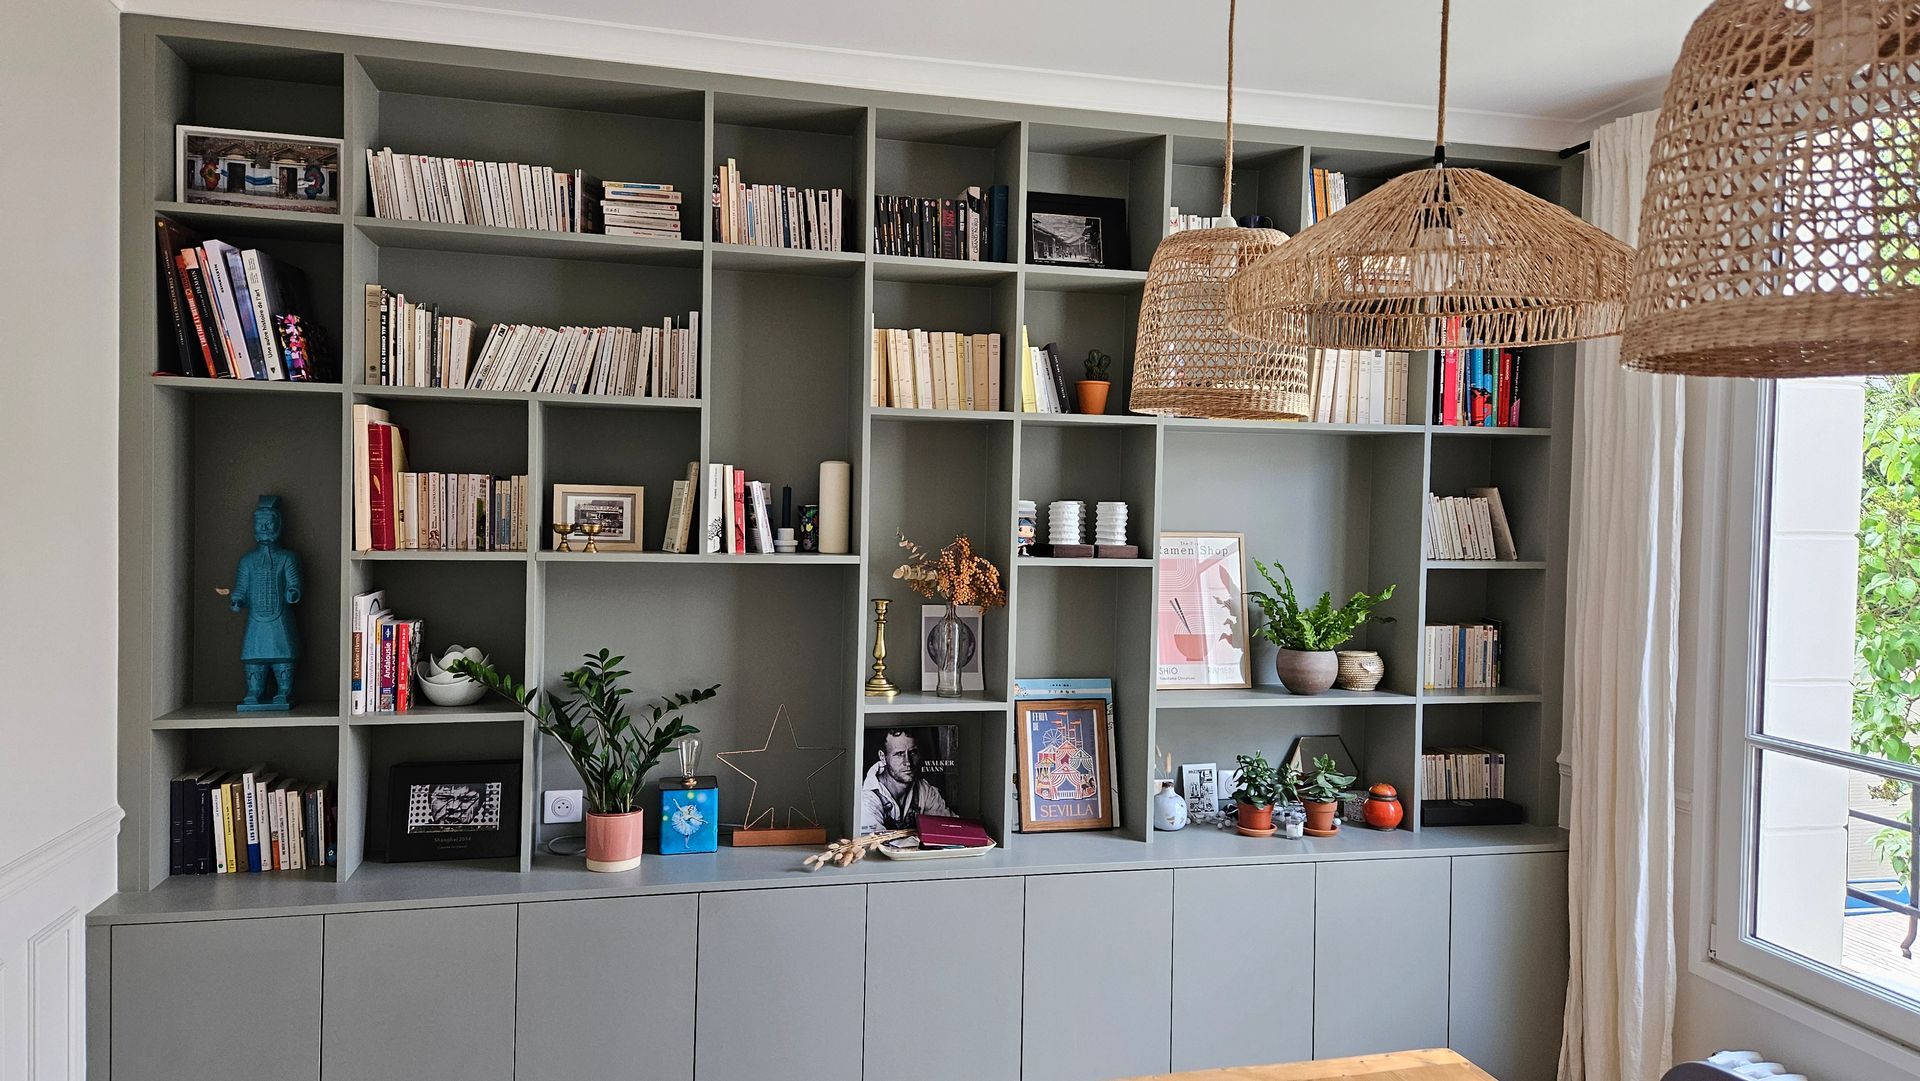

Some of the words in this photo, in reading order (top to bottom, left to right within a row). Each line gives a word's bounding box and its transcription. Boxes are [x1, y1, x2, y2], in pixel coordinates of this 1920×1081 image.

[191, 270, 202, 294] DEMAIN
[258, 310, 267, 331] histoire
[382, 364, 386, 372] ME
[1200, 545, 1228, 557] Shop
[383, 643, 392, 678] Andalousie
[1159, 666, 1178, 675] SHIO
[1208, 666, 1235, 675] RAMEN
[1032, 712, 1048, 721] FERIA
[1032, 723, 1039, 731] DE
[1040, 803, 1094, 818] SEVILLA
[434, 836, 458, 844] Shanghai
